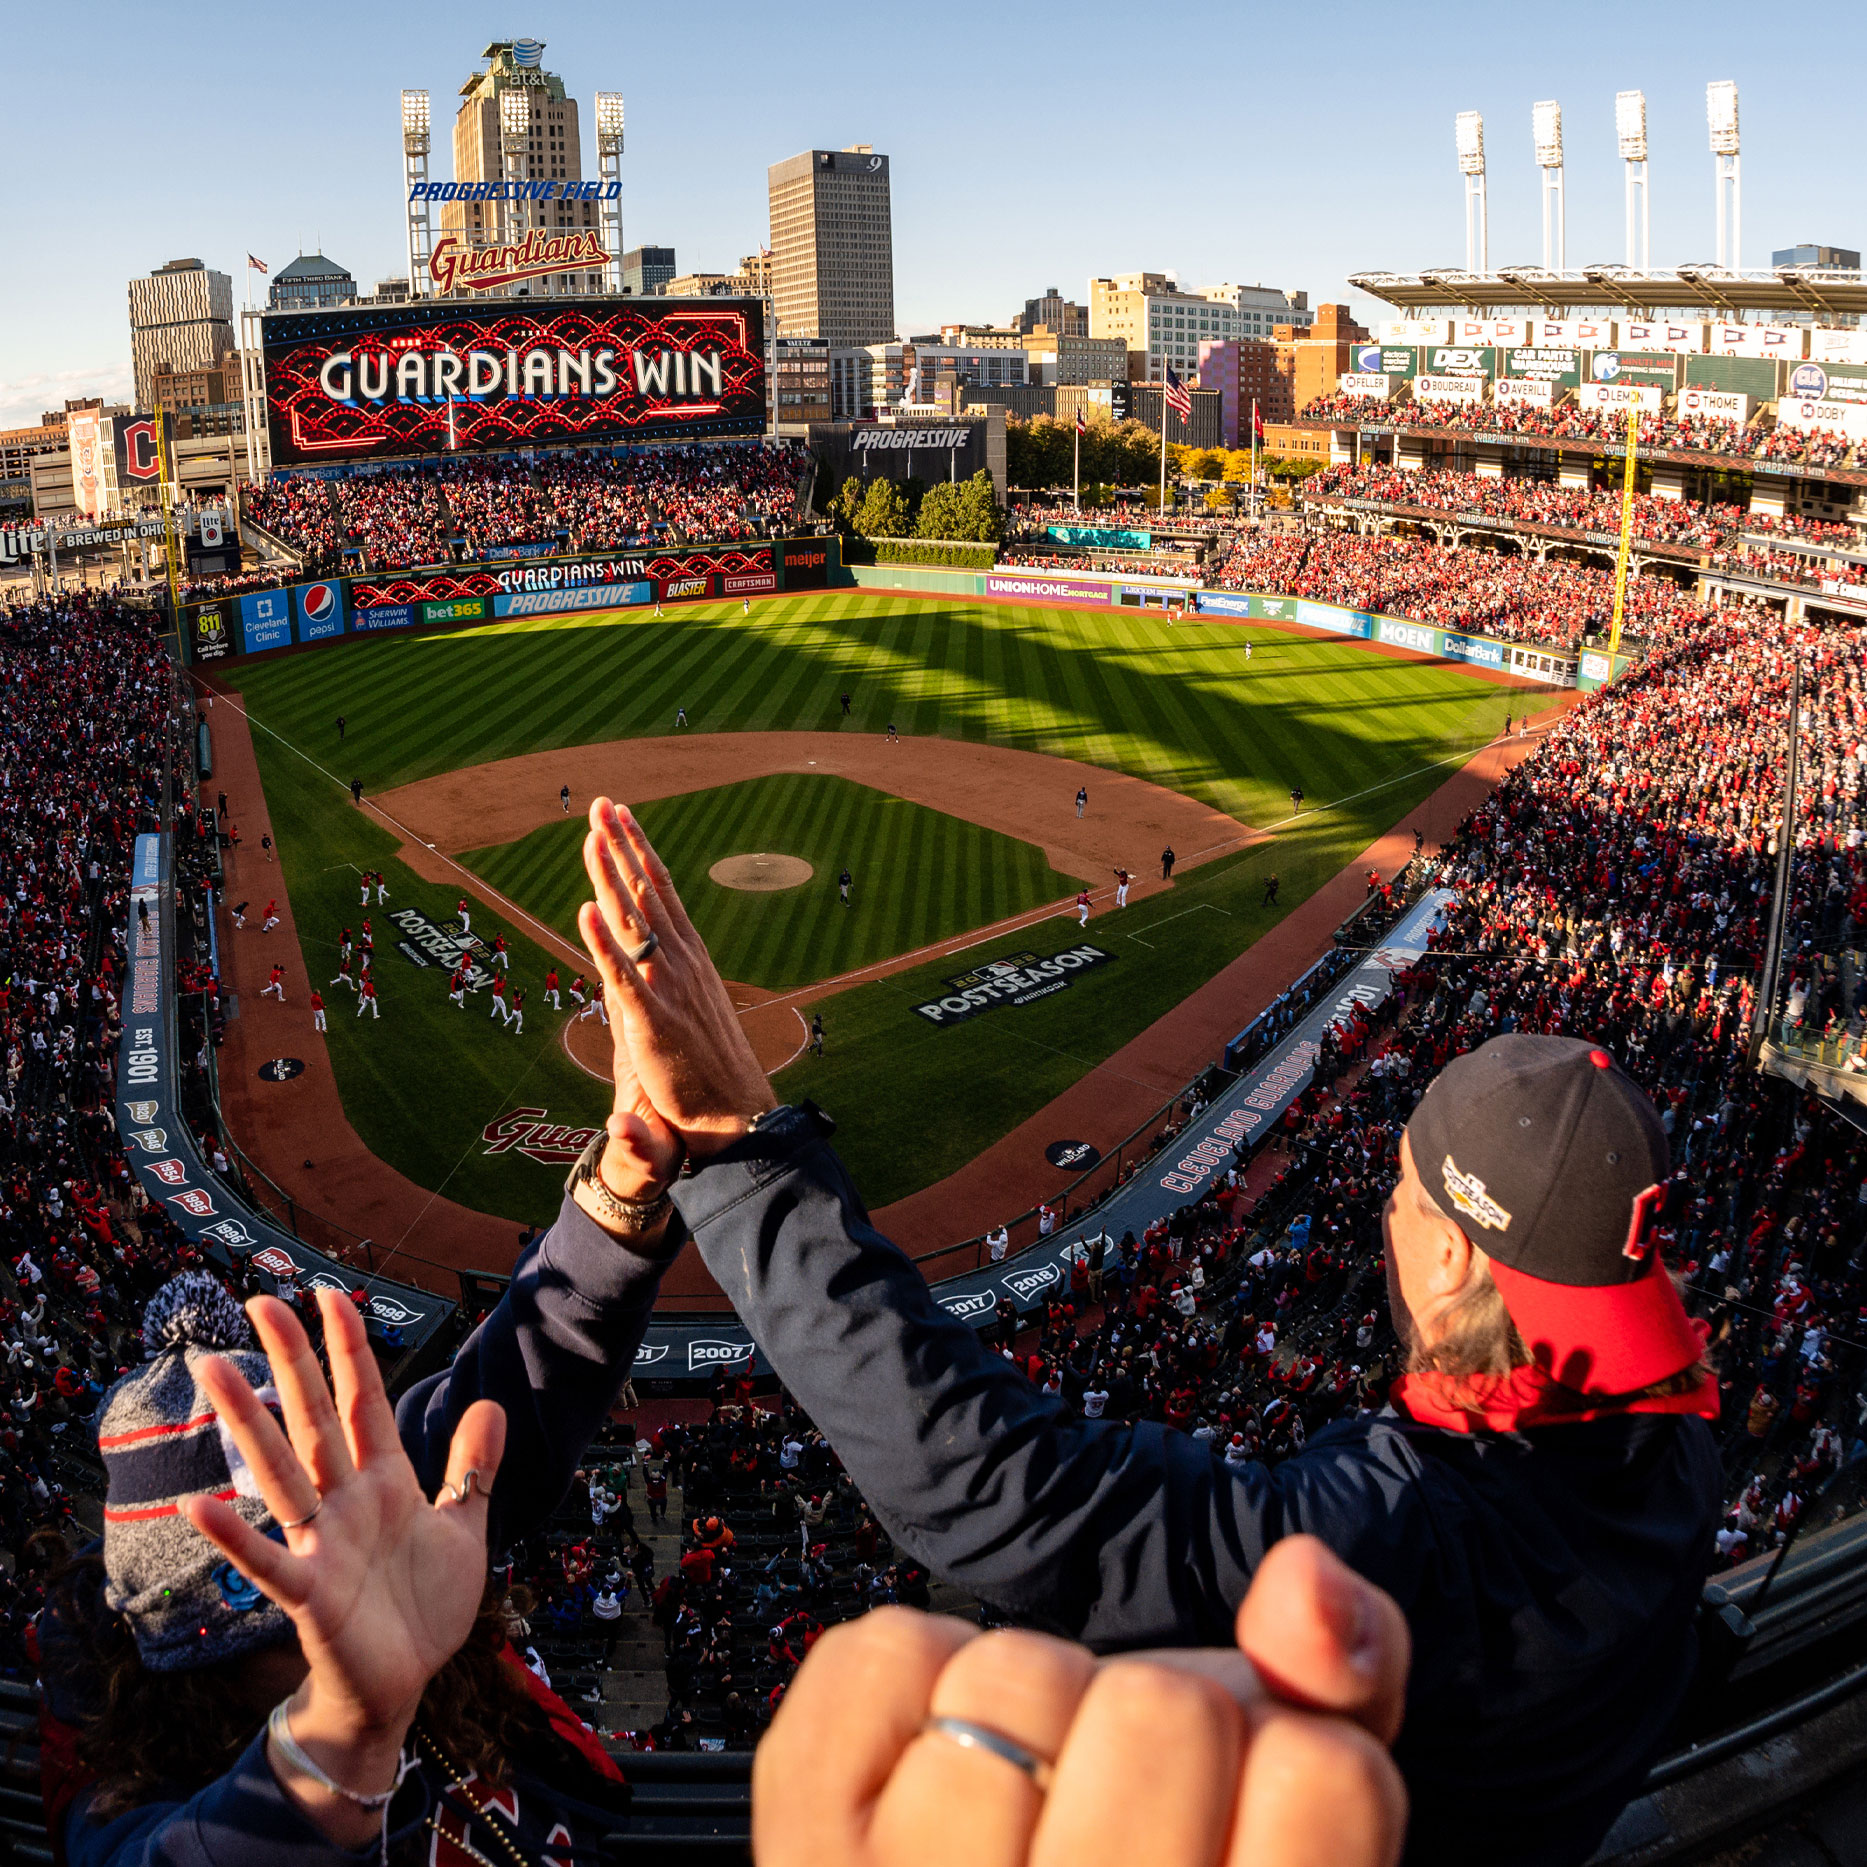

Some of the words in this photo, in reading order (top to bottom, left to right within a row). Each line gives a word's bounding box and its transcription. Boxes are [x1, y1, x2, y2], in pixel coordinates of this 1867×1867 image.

[509, 70, 548, 86] at&t
[409, 181, 558, 201] PROGRESSIVE
[561, 181, 623, 200] FIELD
[429, 228, 612, 294] Guardians
[1433, 349, 1485, 368] DEX
[1513, 349, 1536, 360] CAR
[1537, 350, 1573, 361] PARTS
[1621, 357, 1654, 367] MINUTE
[1656, 359, 1675, 368] MEN
[1510, 359, 1575, 372] WAREHOUSE
[1621, 365, 1648, 373] STAFFING
[1649, 367, 1674, 375] SERVICES
[320, 349, 618, 400] GUARDIANS
[633, 349, 722, 397] WIN
[1356, 377, 1385, 389] FELLER
[1432, 380, 1476, 393] BOUDREAU
[1511, 383, 1547, 396] AVERILL
[1611, 389, 1644, 403] LEMON
[1703, 394, 1739, 410] THOME
[1817, 406, 1846, 421] DOBY
[1359, 424, 1393, 434] GUARDIANS
[1394, 425, 1408, 434] WIN
[853, 429, 970, 450] PROGRESSIVE
[1473, 432, 1514, 444] GUARDIANS
[1515, 435, 1530, 444] WIN
[124, 420, 161, 479] C
[1652, 448, 1668, 459] WIN
[1753, 460, 1805, 475] GUARDIANS
[1807, 466, 1826, 477] WIN
[1343, 497, 1380, 509] GUARDIANS
[1381, 502, 1394, 511] WIN
[100, 519, 135, 530] PROUDLY
[202, 516, 219, 528] Lite
[1456, 512, 1498, 525] GUARDIANS
[1499, 517, 1514, 528] WIN
[66, 528, 121, 548] BREWED
[123, 526, 138, 540] IN
[1633, 538, 1651, 550] WIN
[0, 529, 45, 563] Lite
[784, 550, 826, 569] meijer
[498, 563, 604, 587] GUARDIANS
[612, 559, 646, 576] WIN
[666, 581, 707, 598] BLASTER
[727, 577, 772, 588] CRAFTSMAN
[508, 586, 634, 614] PROGRESSIVE
[1067, 590, 1108, 599] MORTGAGE
[369, 608, 408, 620] SHERWIN
[427, 603, 482, 620] bet365
[198, 613, 221, 633] 811
[245, 616, 288, 633] Cleveland
[309, 622, 335, 637] pepsi
[255, 630, 280, 643] Clinic
[1380, 622, 1432, 648] MOEN
[197, 645, 209, 653] Call
[209, 642, 229, 651] before
[201, 651, 213, 660] you
[1444, 637, 1500, 663] DollarBank
[1535, 671, 1570, 686] CLIFFS
[1010, 953, 1037, 967] 22
[132, 958, 160, 1014] GUARDIANS
[918, 945, 1106, 1021] POSTSEASON
[954, 975, 980, 988] 20
[134, 1027, 154, 1048] EST.
[127, 1048, 159, 1084] 1901
[136, 1102, 150, 1120] 1920
[1160, 1109, 1262, 1194] CLEVELAND
[1243, 1040, 1321, 1111] GUARDIANS
[142, 1131, 162, 1150] 1948
[158, 1161, 181, 1183] 1954
[182, 1192, 210, 1213] 1995
[215, 1223, 245, 1244] 1996
[257, 1250, 293, 1273] 1997
[1013, 1270, 1055, 1292] 2018
[693, 1346, 744, 1359] 2007
